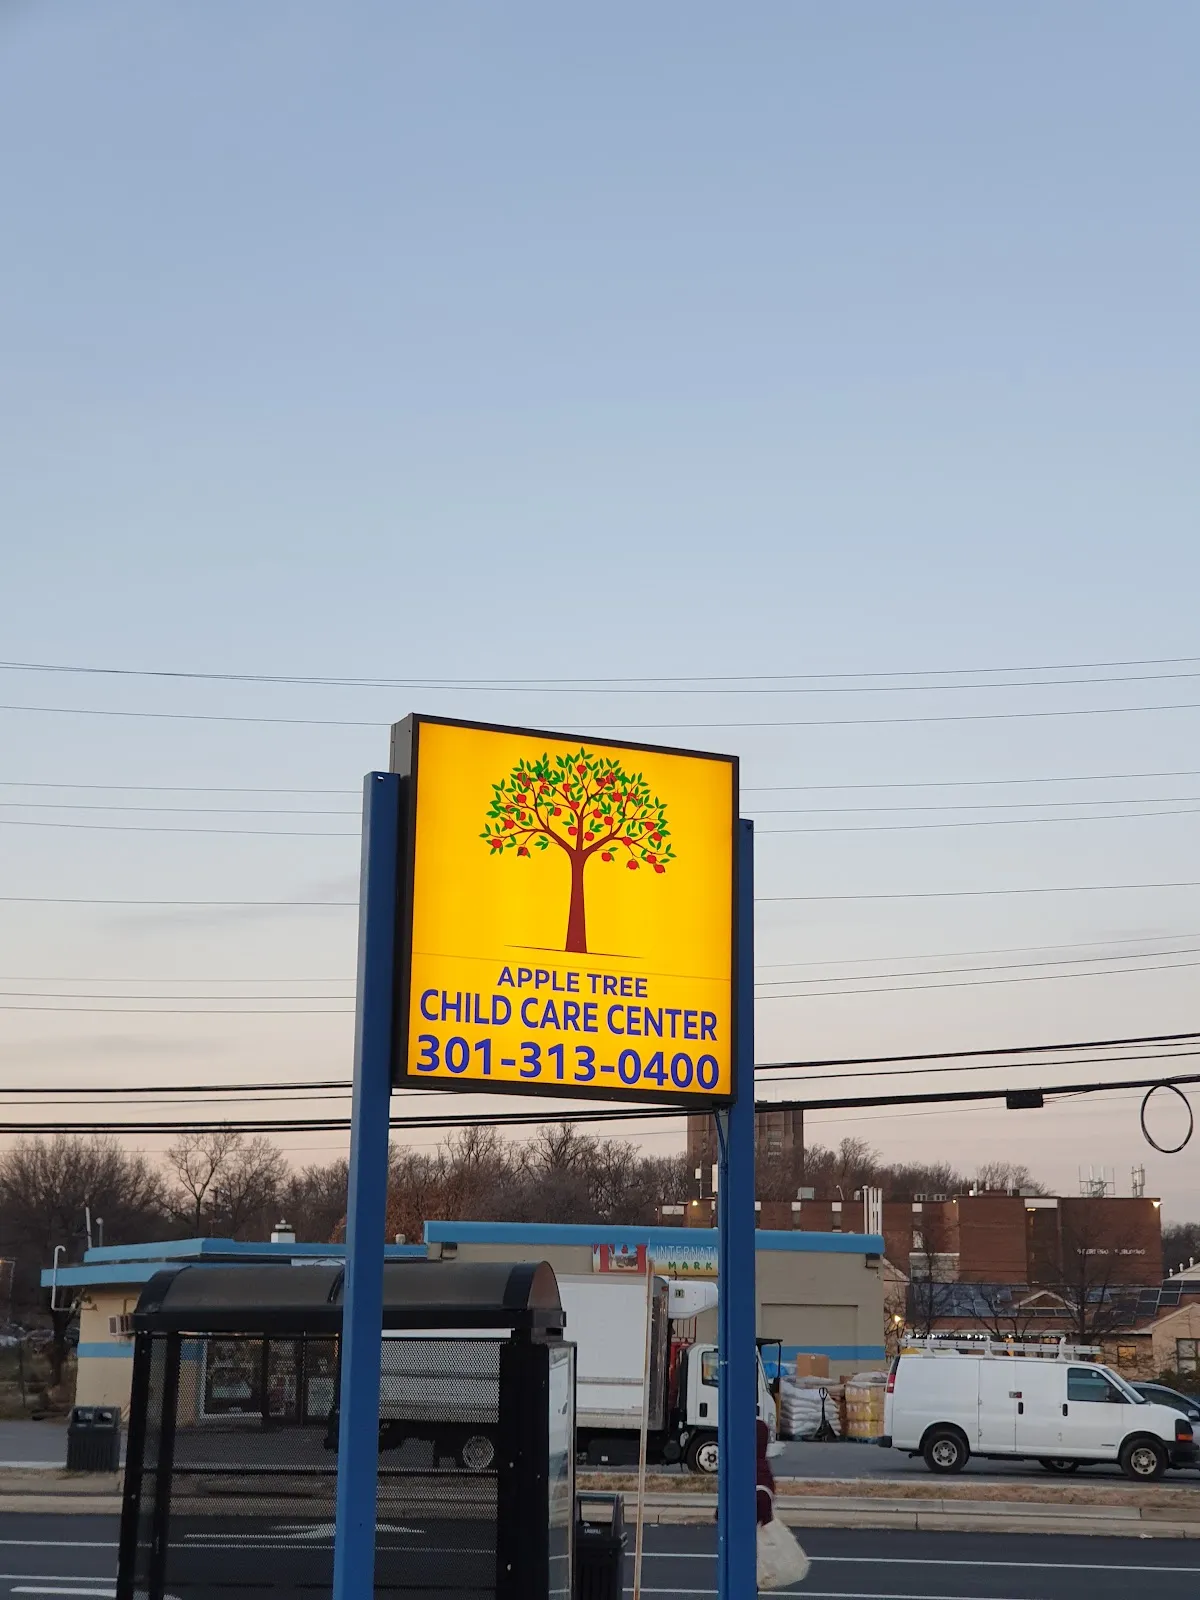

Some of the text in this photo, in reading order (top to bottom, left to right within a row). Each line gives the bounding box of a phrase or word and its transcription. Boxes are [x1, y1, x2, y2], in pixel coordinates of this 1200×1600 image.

[497, 966, 649, 999] APPLE TREE
[420, 989, 718, 1041] CHILD CARE CENTER
[416, 1034, 719, 1089] 301-313-0400
[655, 1245, 717, 1261] INTERNATI
[667, 1261, 713, 1271] MARK
